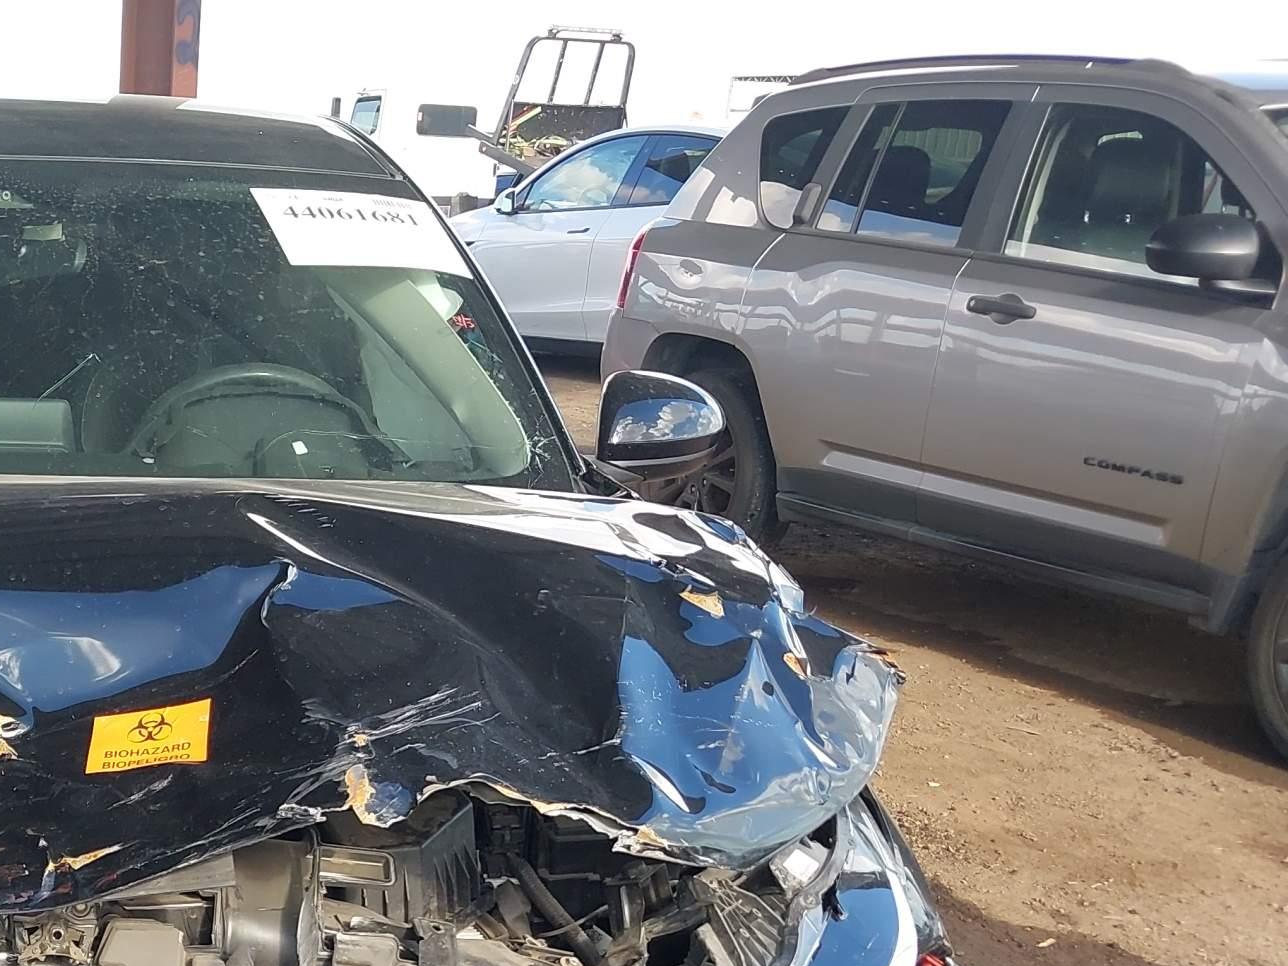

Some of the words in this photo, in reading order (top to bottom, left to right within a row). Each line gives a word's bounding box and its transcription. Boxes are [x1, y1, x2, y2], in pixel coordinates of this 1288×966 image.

[283, 205, 419, 227] 44061681
[1083, 456, 1185, 485] COMPASS
[101, 753, 191, 769] BIOPELIGRO
[103, 742, 192, 760] BIOHAZARD
